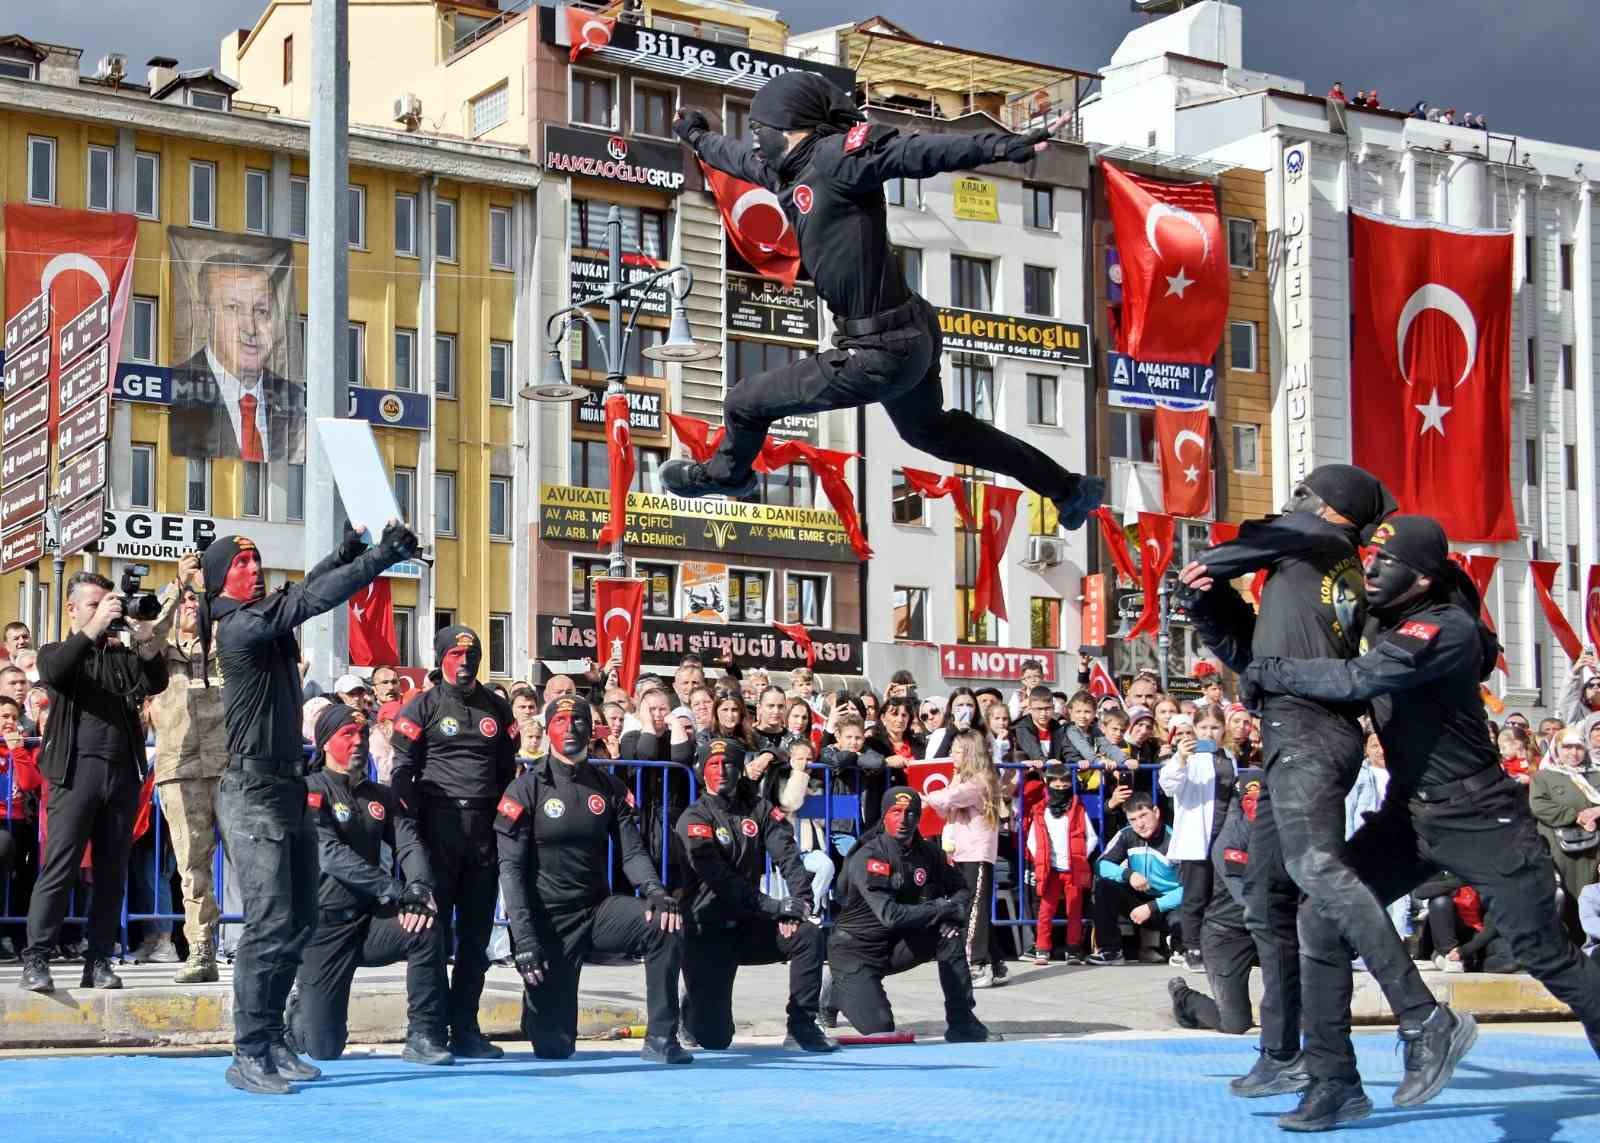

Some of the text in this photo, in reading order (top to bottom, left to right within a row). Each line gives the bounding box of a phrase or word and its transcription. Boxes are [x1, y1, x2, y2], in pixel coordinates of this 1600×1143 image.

[636, 31, 824, 80] Bilge Gro
[938, 308, 1080, 350] üderrisoglu
[1137, 362, 1190, 379] ANAHTAR
[627, 494, 638, 507] &
[642, 494, 748, 518] ARABULUCULUK
[752, 506, 761, 519] &
[799, 530, 825, 543] EMRE
[944, 650, 965, 671] 1.
